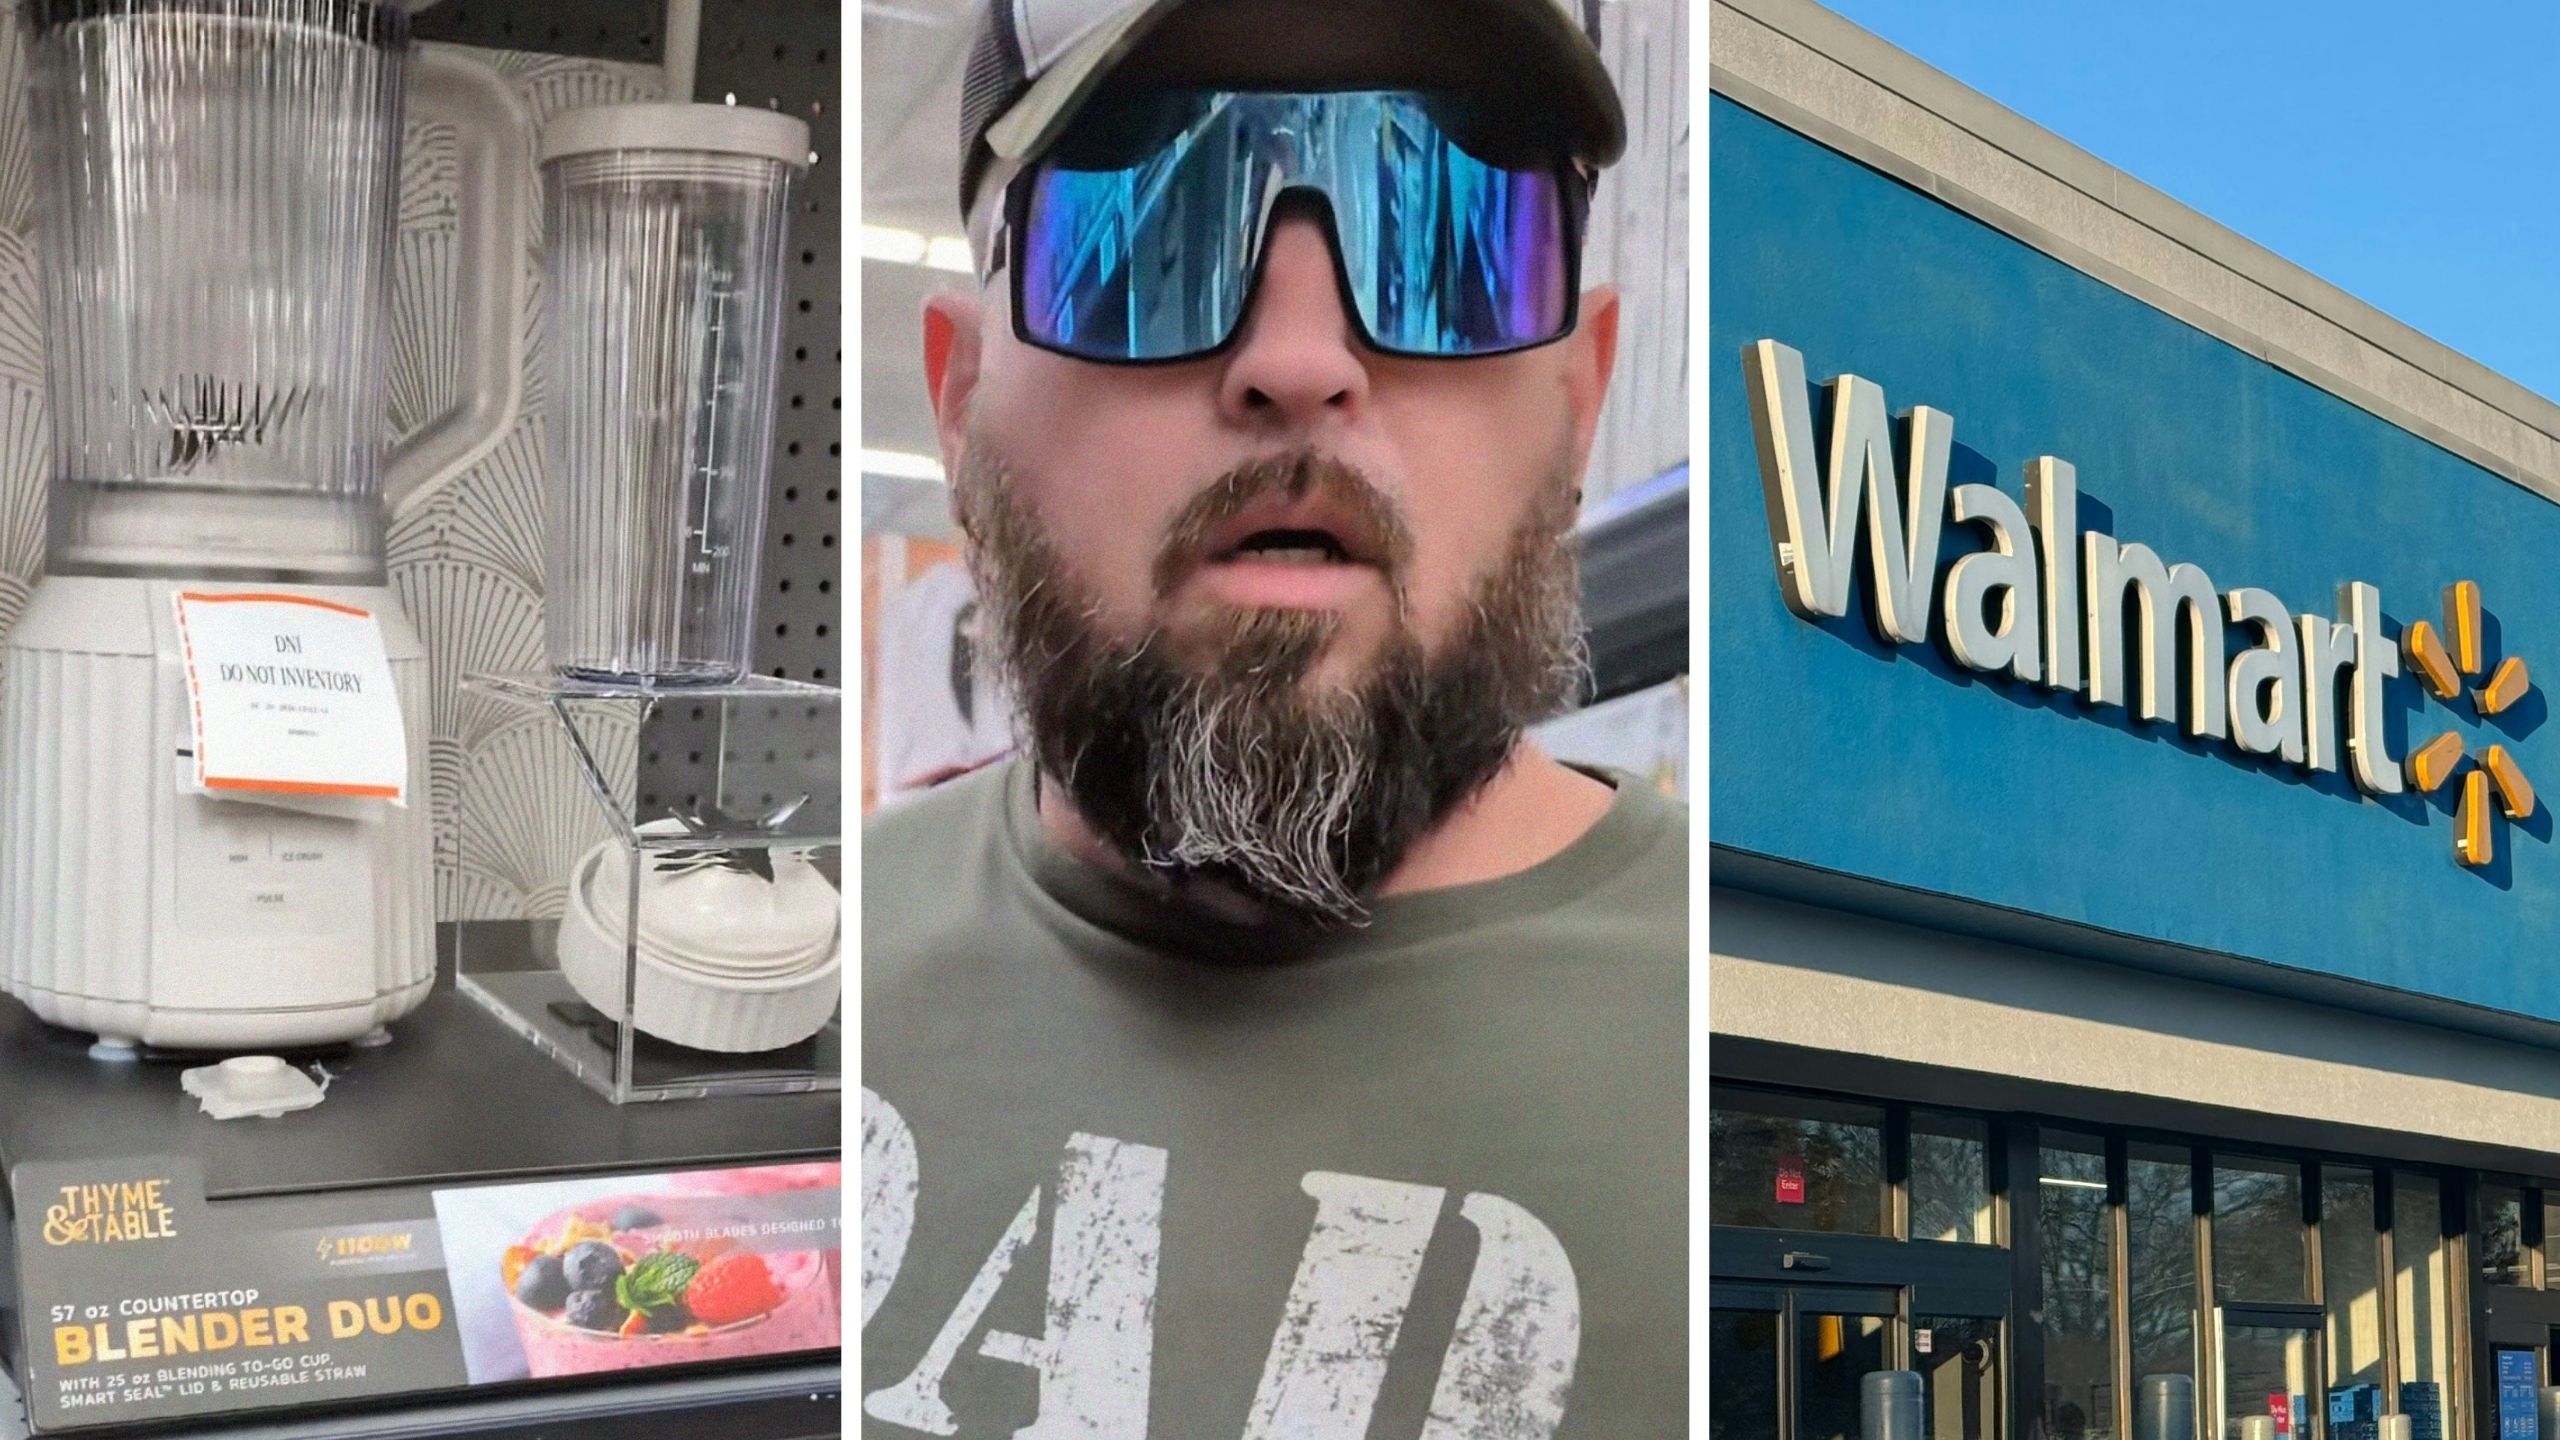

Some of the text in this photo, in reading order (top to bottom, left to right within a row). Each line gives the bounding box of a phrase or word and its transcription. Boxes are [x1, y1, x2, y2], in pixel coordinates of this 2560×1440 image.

[1742, 338, 2402, 794] Walmart
[275, 634, 302, 654] DNI
[220, 664, 362, 693] DO NOT INVENTORY
[60, 1179, 165, 1216] THYME
[1781, 1179, 1799, 1190] Enter
[85, 1207, 177, 1244] TABLE
[705, 1225, 757, 1239] BLADES
[761, 1218, 826, 1235] DESIGNED
[862, 1085, 1581, 1440] AD
[120, 1288, 260, 1317] COUNTERTOP
[54, 1292, 442, 1366] BLENDER DUO
[59, 1376, 100, 1393] WITH
[107, 1373, 126, 1388] 25
[156, 1362, 236, 1382] BLENDING
[241, 1356, 294, 1374] TO-GO
[60, 1390, 116, 1409] SMART
[179, 1381, 205, 1396] LID
[211, 1380, 223, 1393] &
[229, 1370, 310, 1390] REUSABLE
[314, 1364, 367, 1383] STRAW
